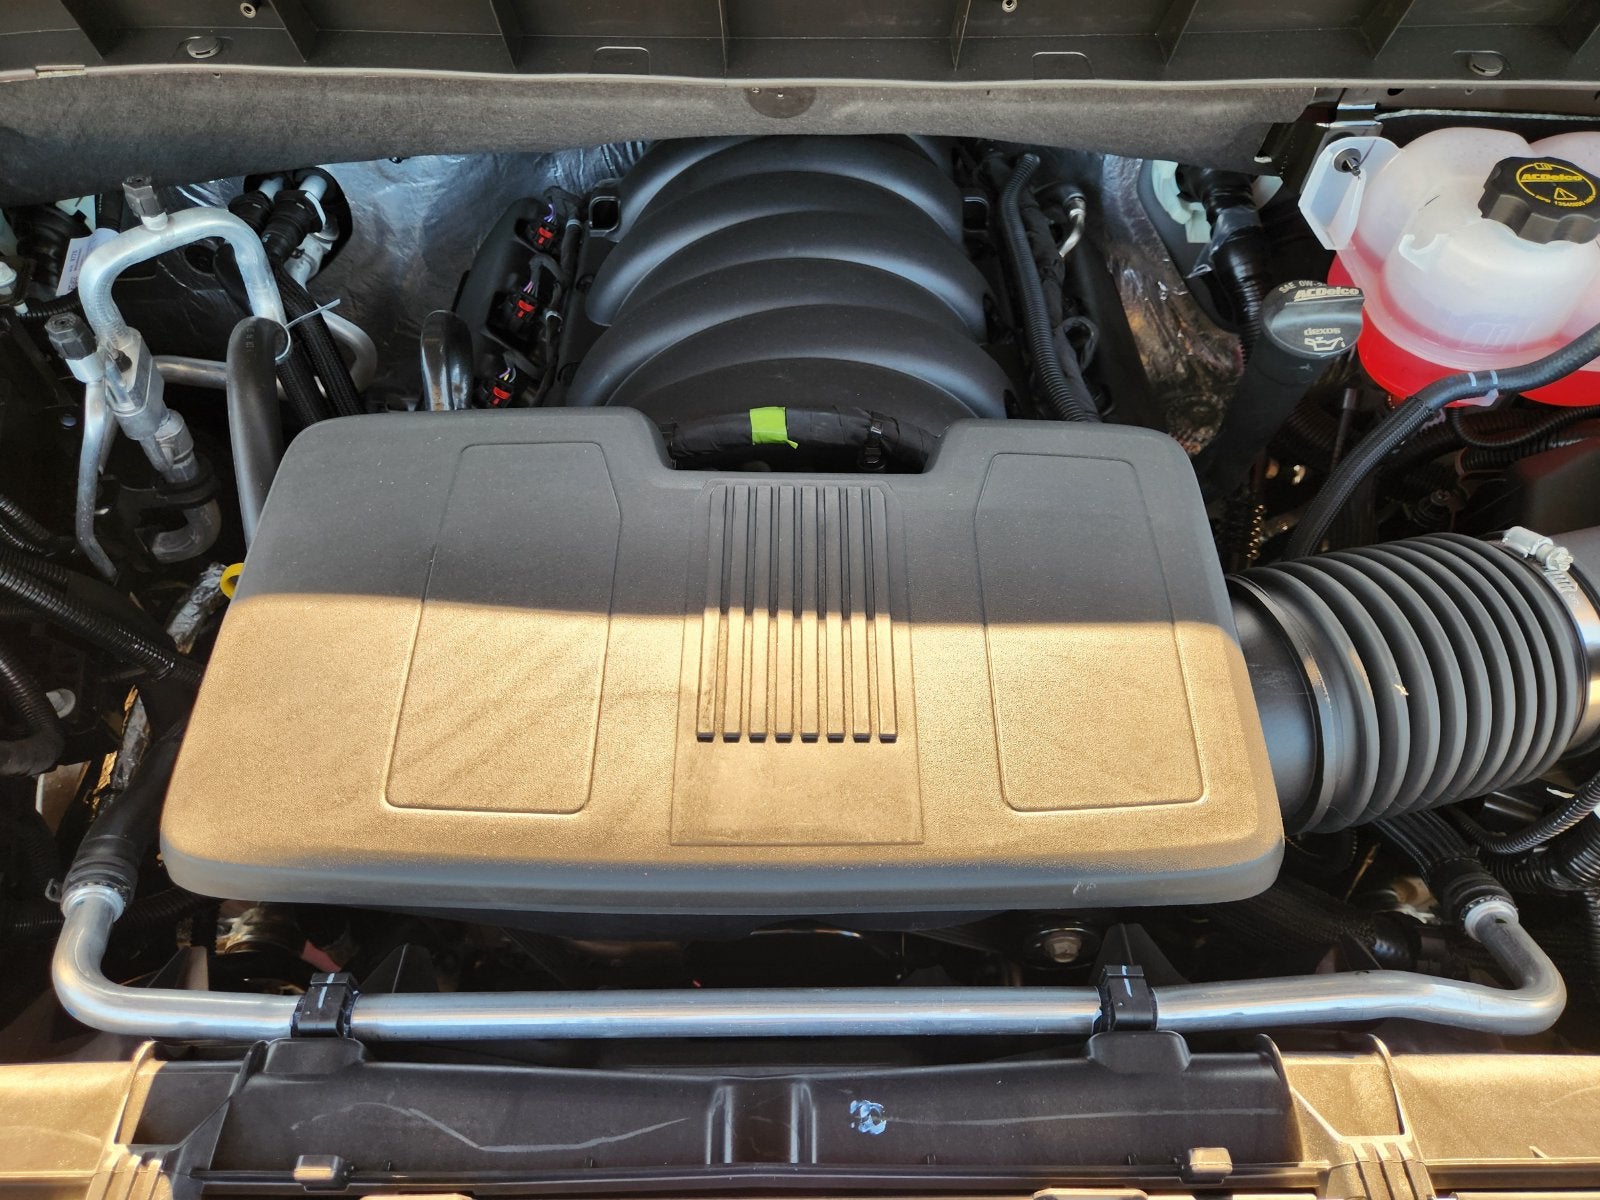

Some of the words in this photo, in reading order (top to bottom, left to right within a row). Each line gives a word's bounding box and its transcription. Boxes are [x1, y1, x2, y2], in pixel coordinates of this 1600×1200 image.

[1521, 173, 1583, 182] ACDelco
[1279, 282, 1297, 294] SAE
[1294, 286, 1360, 301] ACDelco
[1303, 327, 1341, 336] dexos
